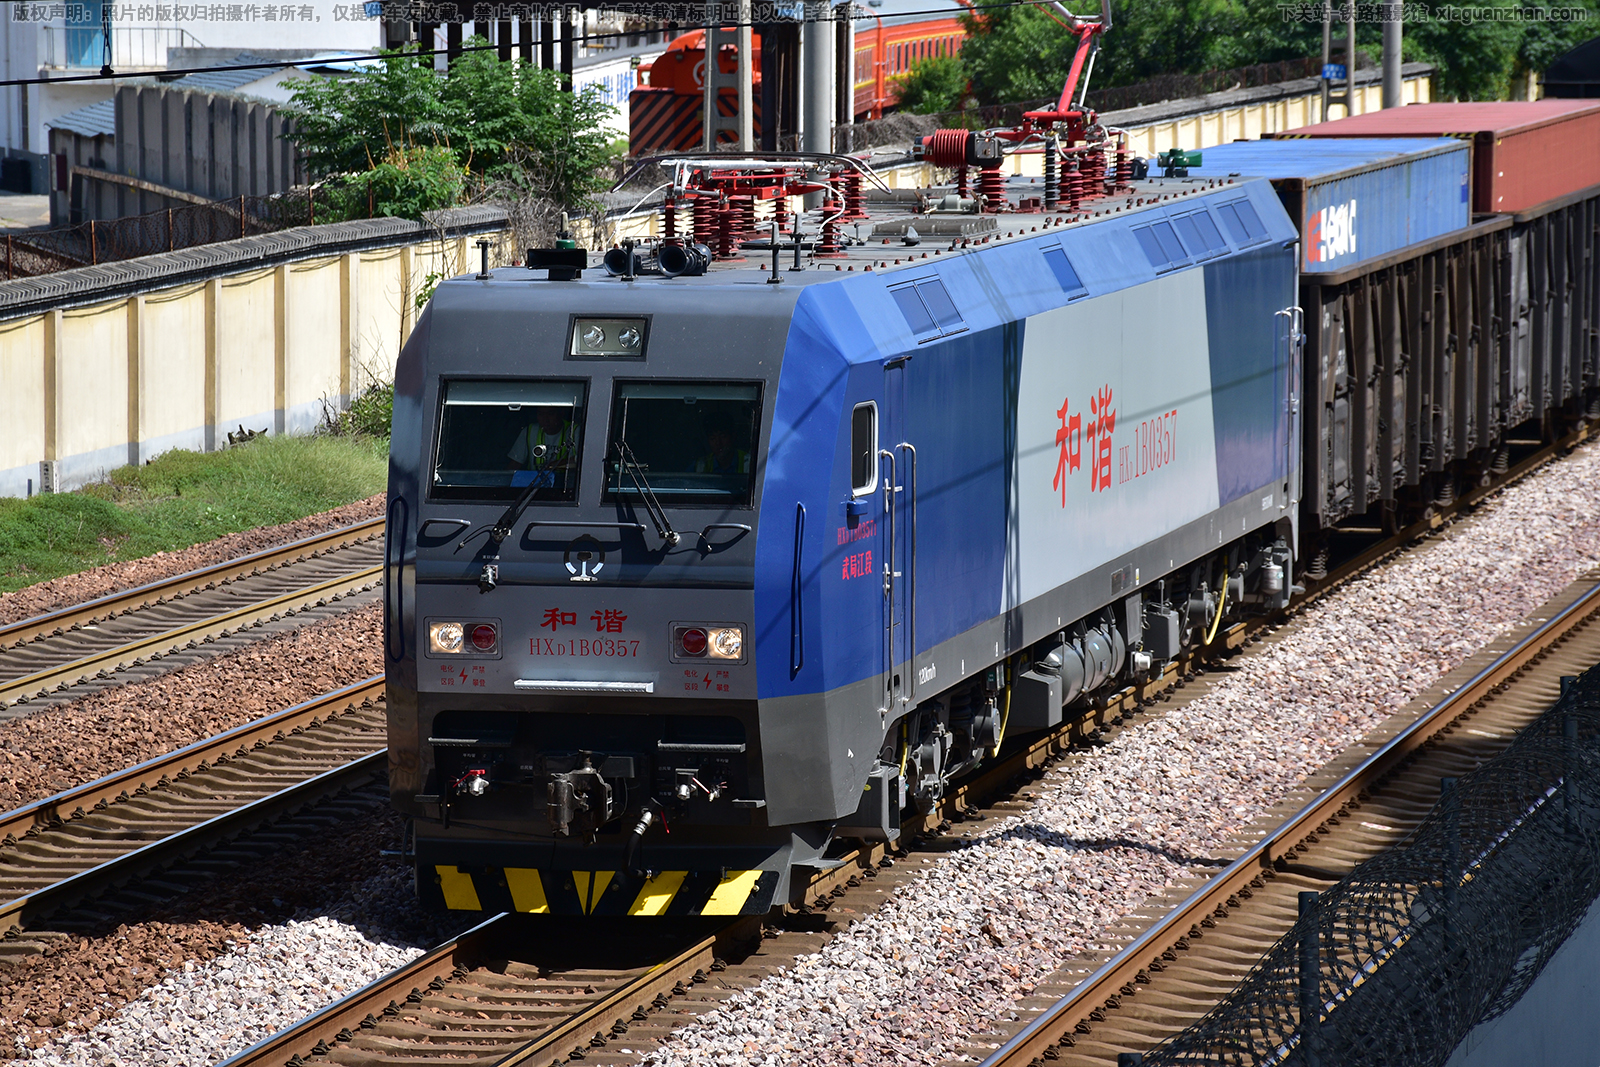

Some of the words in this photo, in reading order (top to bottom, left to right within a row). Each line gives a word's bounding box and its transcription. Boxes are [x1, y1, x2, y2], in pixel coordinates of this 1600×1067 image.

[1053, 383, 1116, 509] 和谐
[540, 607, 628, 633] 和谐
[529, 637, 640, 657] HXD1B0357
